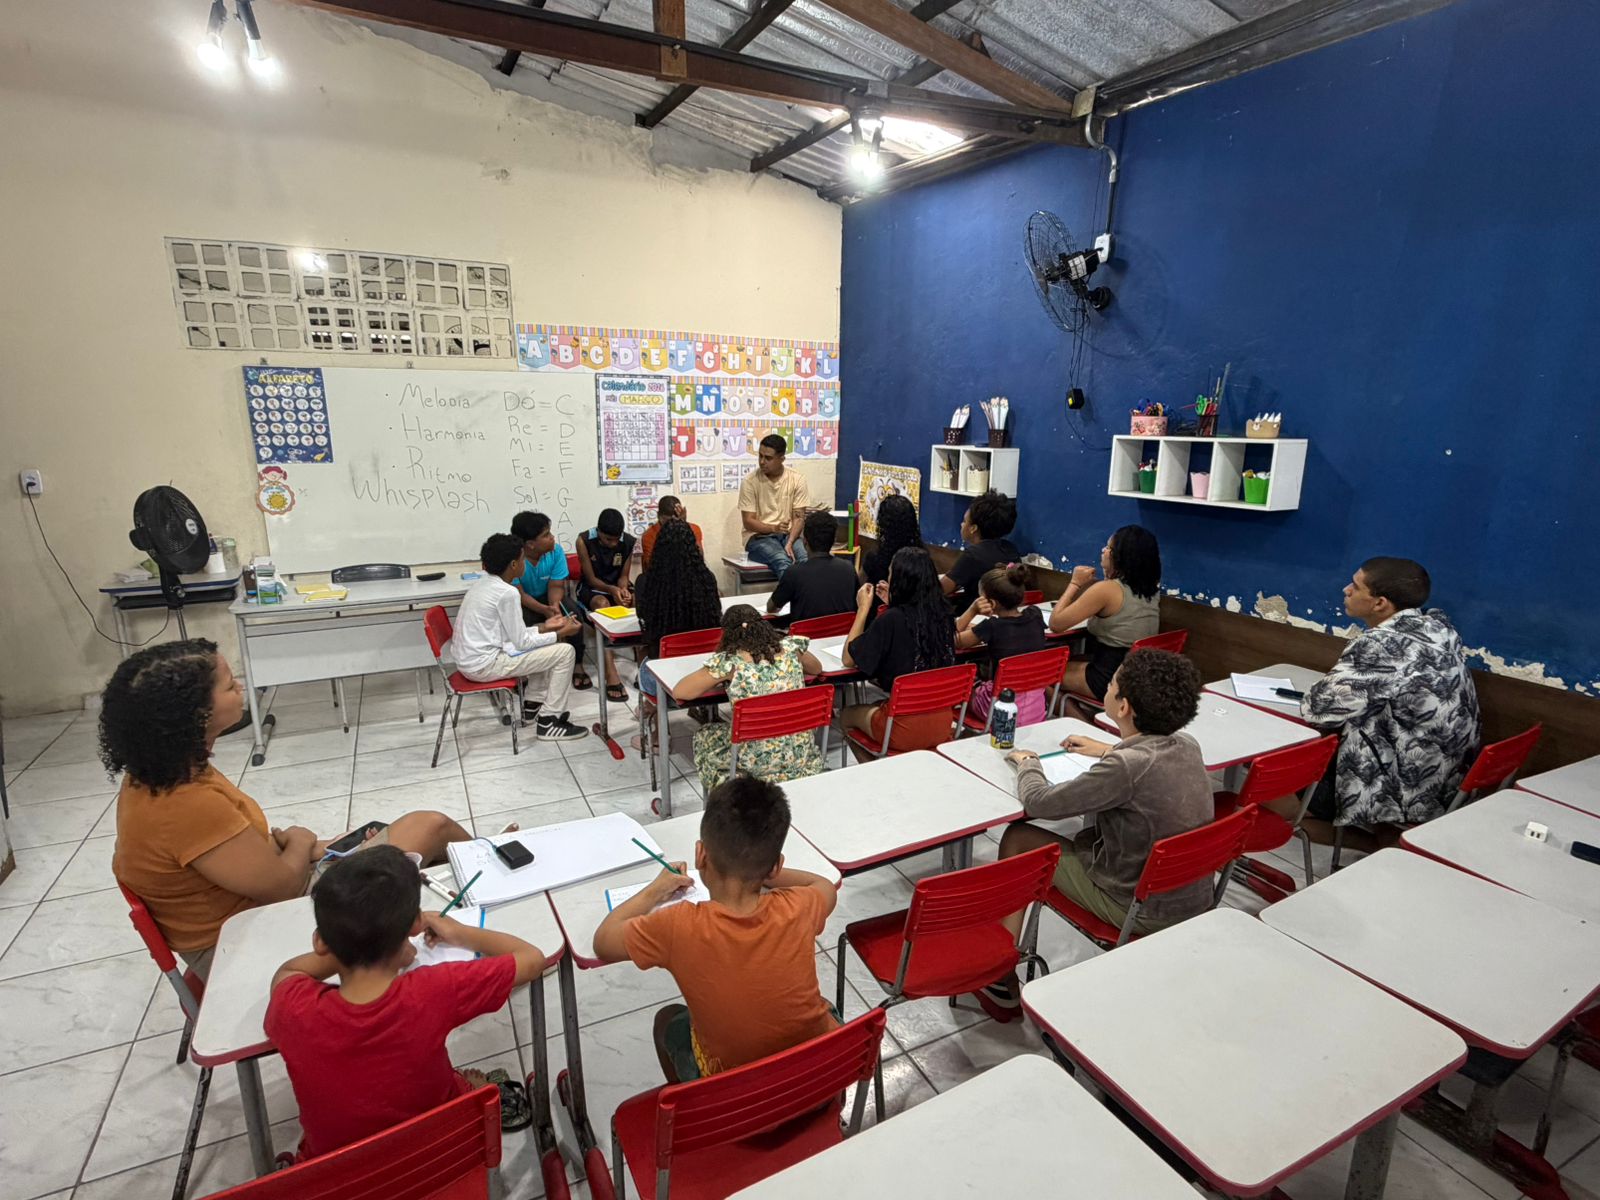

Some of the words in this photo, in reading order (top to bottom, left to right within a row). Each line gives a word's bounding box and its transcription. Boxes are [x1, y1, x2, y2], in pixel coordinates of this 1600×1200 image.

[527, 339, 543, 359] A
[558, 344, 574, 363] B
[589, 345, 604, 365] C
[619, 347, 634, 366] D
[650, 348, 662, 366] E
[677, 349, 688, 367] F
[703, 350, 715, 369] G
[728, 352, 740, 370] H
[755, 355, 762, 372] I
[776, 355, 788, 372] J
[800, 357, 812, 374] K
[823, 358, 831, 374] L
[555, 394, 575, 415] C
[674, 394, 692, 411] M
[702, 395, 716, 412] N
[728, 396, 741, 412] O
[753, 396, 765, 412] P
[778, 397, 790, 415] Q
[801, 398, 813, 414] R
[824, 397, 834, 413] S
[401, 413, 486, 441] Harmonia
[560, 423, 575, 438] D
[559, 441, 574, 456] E
[677, 435, 689, 452] T
[703, 436, 715, 452] U
[729, 436, 741, 452] V
[801, 436, 811, 452] Y
[822, 436, 832, 451] Z
[406, 445, 472, 483] Ritmo
[511, 458, 533, 479] Fa
[558, 462, 573, 478] F
[350, 469, 490, 513] Whisplash
[513, 485, 538, 504] Sol
[557, 487, 574, 508] G
[557, 511, 573, 529] A
[557, 532, 573, 552] B
